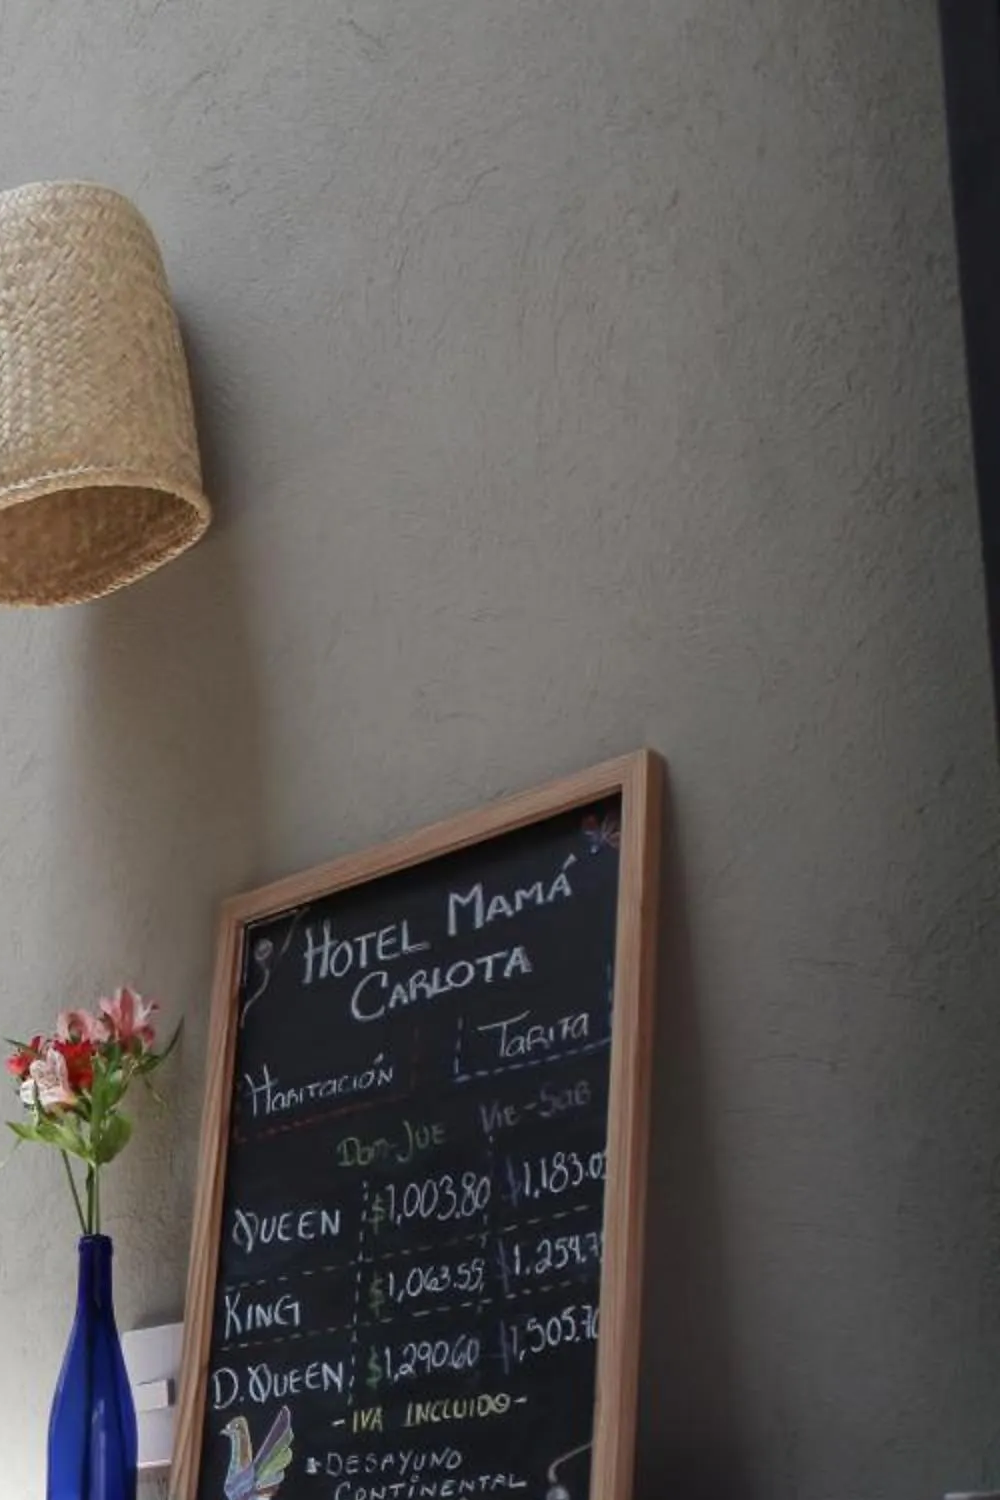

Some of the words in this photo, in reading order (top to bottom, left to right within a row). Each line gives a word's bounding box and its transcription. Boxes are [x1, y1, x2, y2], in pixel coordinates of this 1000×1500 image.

[303, 919, 431, 985] HOTEL
[448, 853, 577, 937] MAMÁ
[351, 945, 533, 1022] CARLOTA
[232, 1208, 341, 1254] QUEEN
[224, 1291, 301, 1341] KING
[326, 1447, 463, 1477] DESAYUNO
